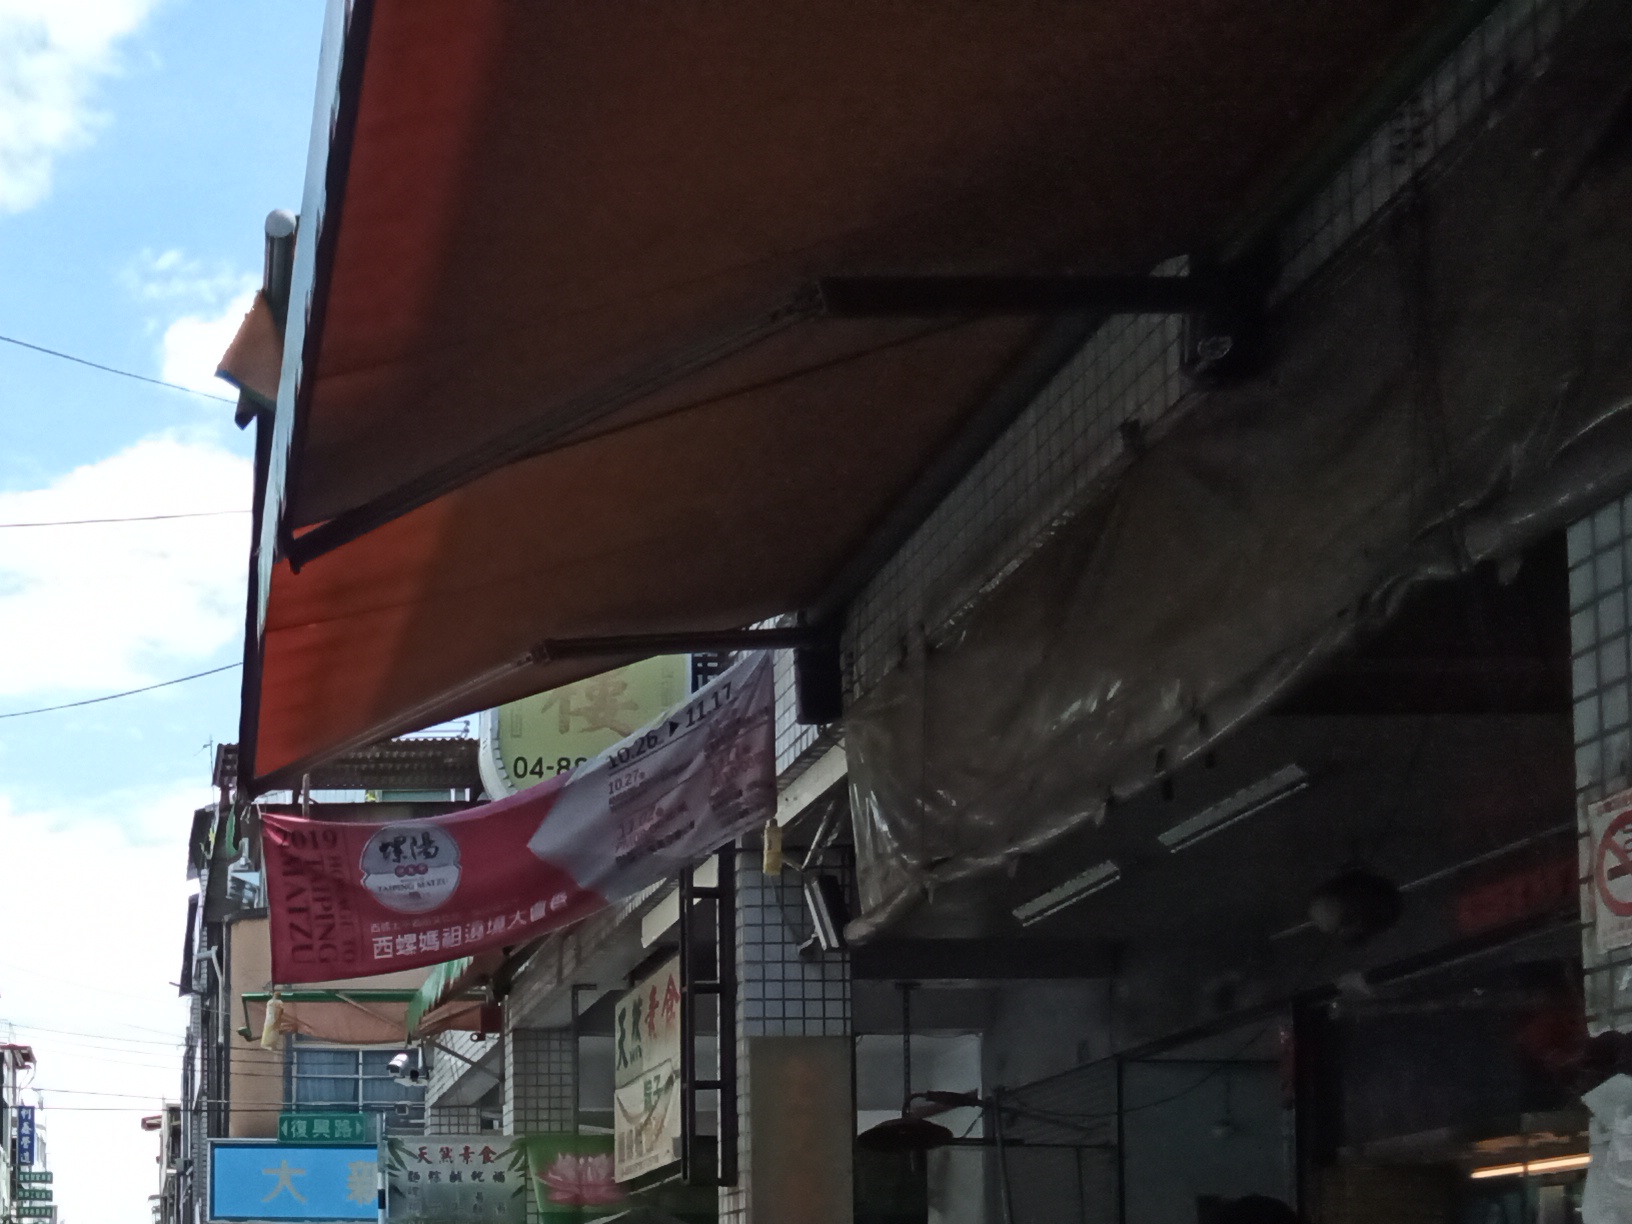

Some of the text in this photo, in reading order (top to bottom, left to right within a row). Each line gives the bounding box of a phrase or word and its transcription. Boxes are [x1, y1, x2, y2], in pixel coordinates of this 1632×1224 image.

[290, 1119, 353, 1139] 復興路
[417, 1145, 498, 1165] 天然素食
